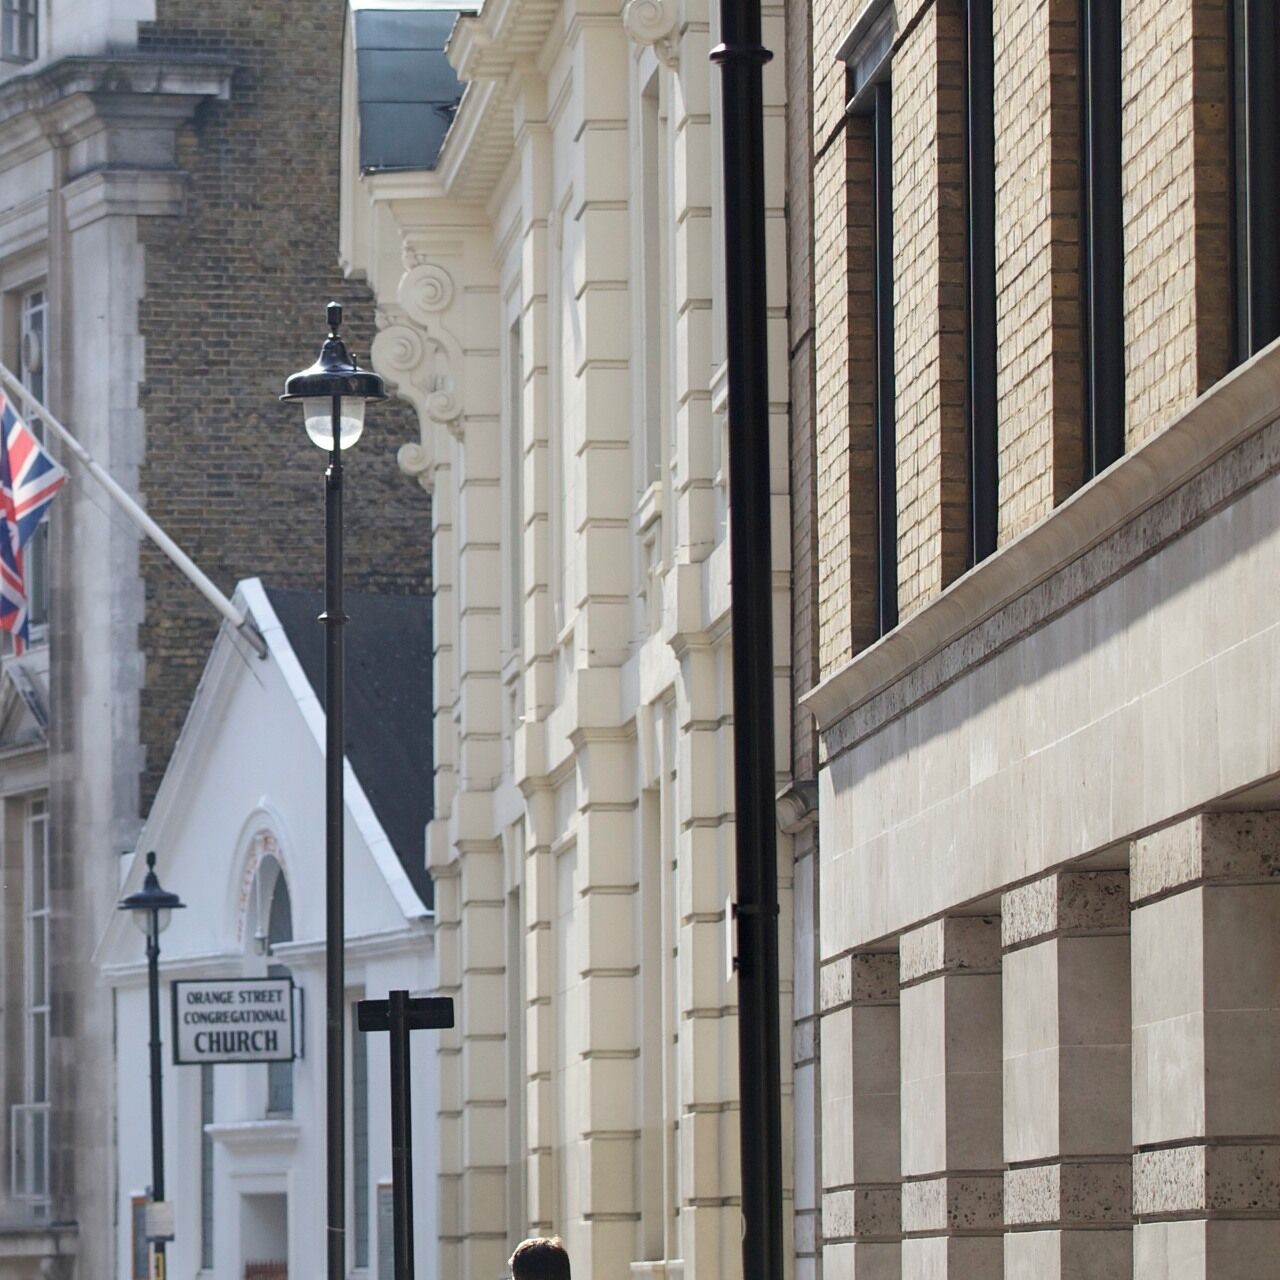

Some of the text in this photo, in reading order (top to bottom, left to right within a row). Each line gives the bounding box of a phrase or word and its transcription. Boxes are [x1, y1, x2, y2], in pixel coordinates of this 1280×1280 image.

[186, 989, 283, 1005] ORANGE STREET
[184, 1009, 287, 1025] CONGREGATIONAL
[194, 1030, 278, 1053] CHURCH
